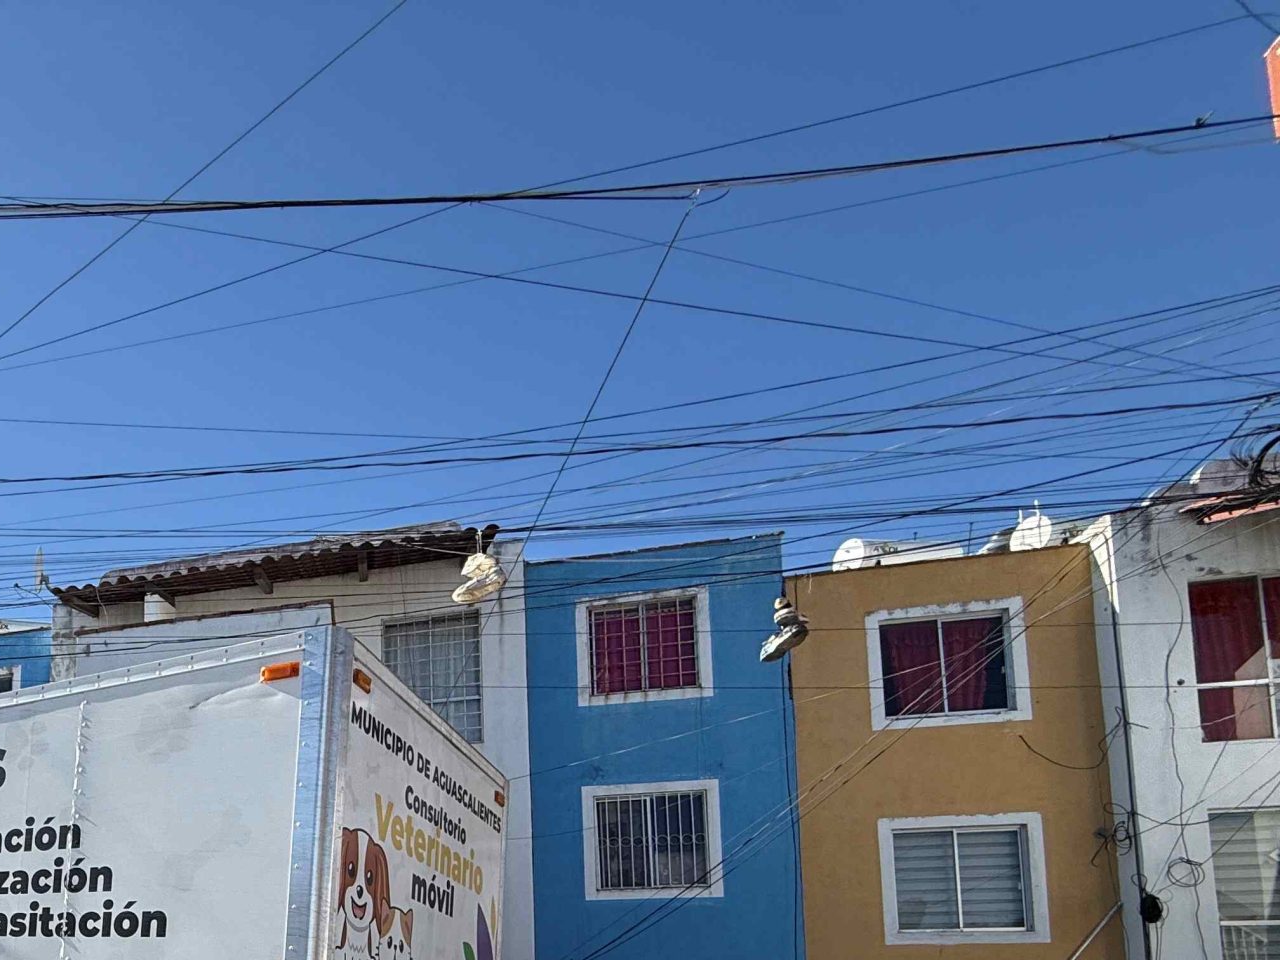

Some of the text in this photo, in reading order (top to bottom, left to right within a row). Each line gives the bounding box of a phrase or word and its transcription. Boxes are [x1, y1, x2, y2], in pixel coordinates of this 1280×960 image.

[351, 702, 502, 834] MUNICIPIO DE AGUASCALIENTES
[374, 792, 484, 895] Veterinario
[405, 784, 467, 845] Consultorio
[411, 872, 455, 918] móvil
